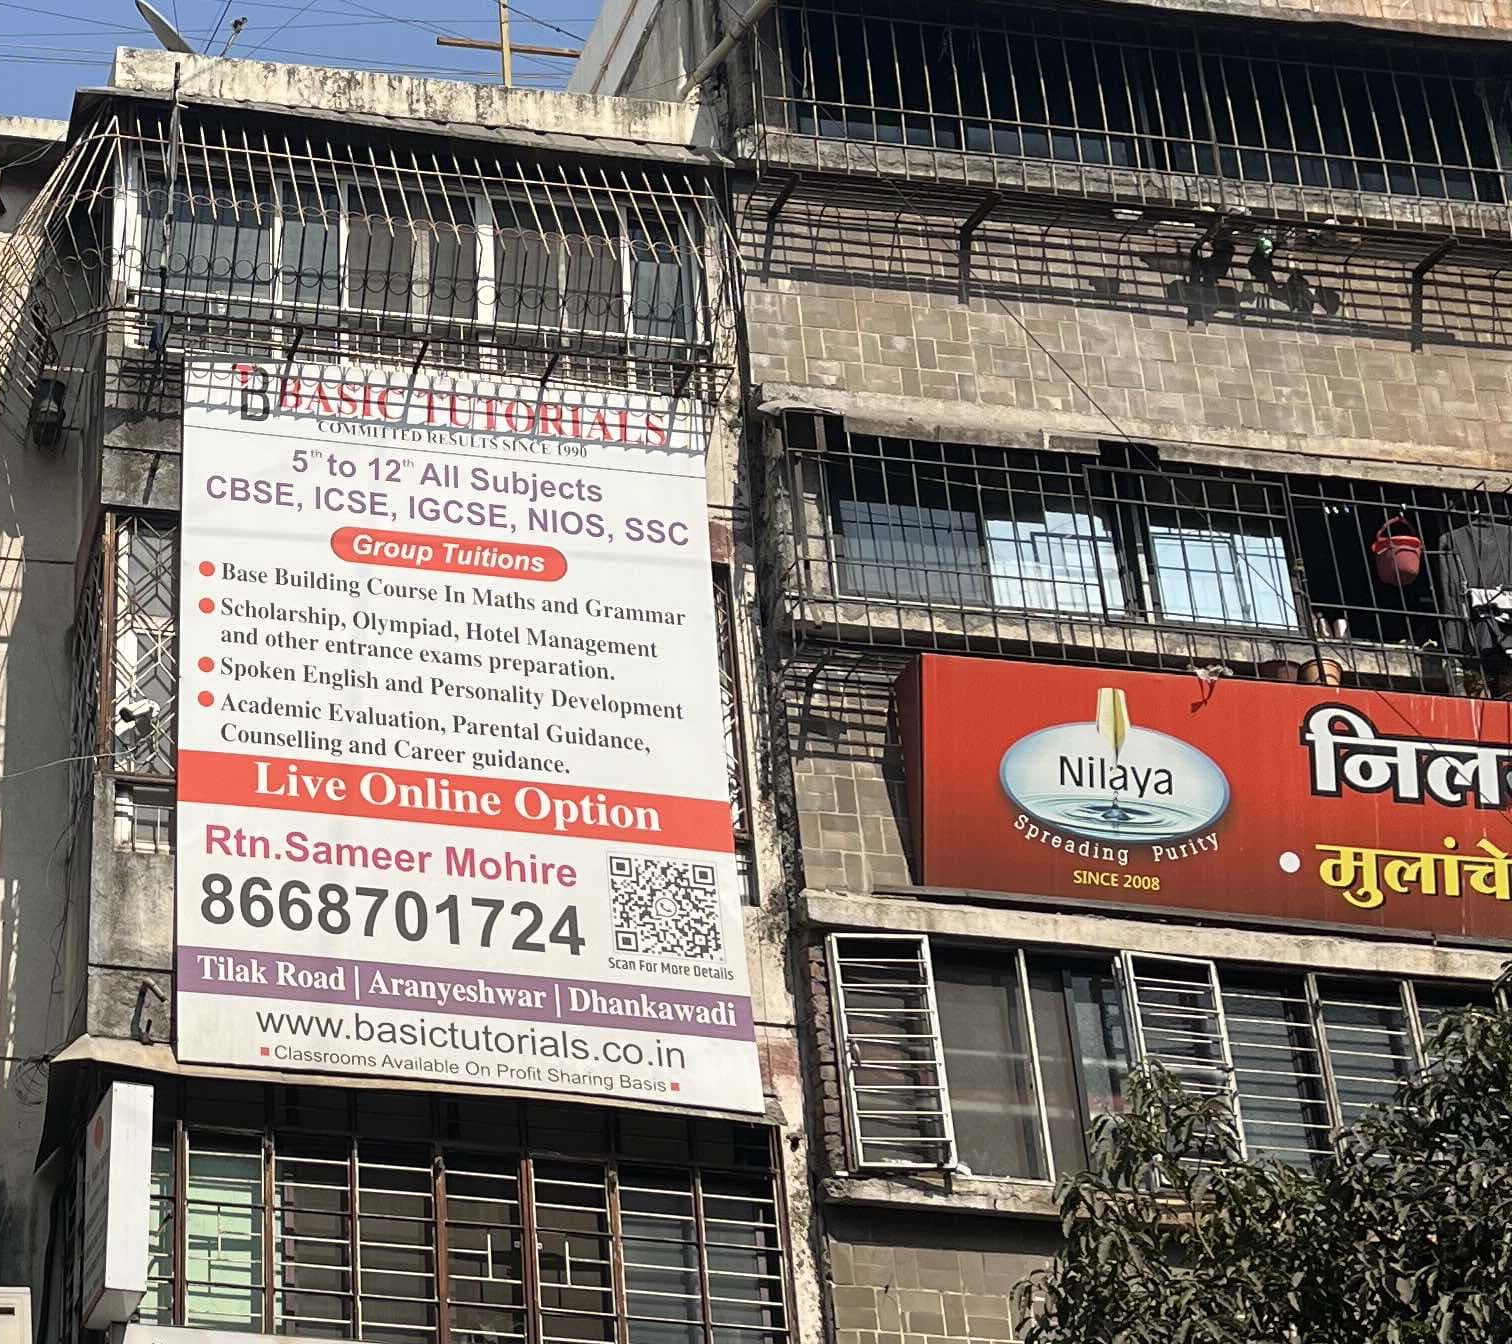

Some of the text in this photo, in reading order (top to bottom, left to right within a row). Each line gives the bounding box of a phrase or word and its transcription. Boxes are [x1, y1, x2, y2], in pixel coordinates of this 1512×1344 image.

[207, 476, 688, 545] CBSE, ICSE, IGCSE, NIOS, SSC
[420, 463, 602, 502] All Subjects
[353, 535, 544, 572] Group Tuitions
[222, 563, 685, 625] Base Building Course Maths and Grammar
[221, 598, 657, 658] Scholarship, Olympiad, Hotel Management
[255, 762, 661, 831] Live Online Option
[1060, 756, 1172, 798] Nilaya
[207, 824, 576, 886] Rtn.Sameer Mohire
[1013, 813, 1221, 866] Spreading Purity
[1074, 871, 1159, 890] SINCE 2008
[201, 873, 585, 955] 8668701724
[197, 955, 736, 1026] Tilak Road Aranyeshwar Dhankawadi
[608, 957, 734, 980] Scan For More Details
[256, 1012, 685, 1068] www.basictutorials.co.in
[275, 1045, 666, 1092] Classrooms Available On Profit Sharing Basis
